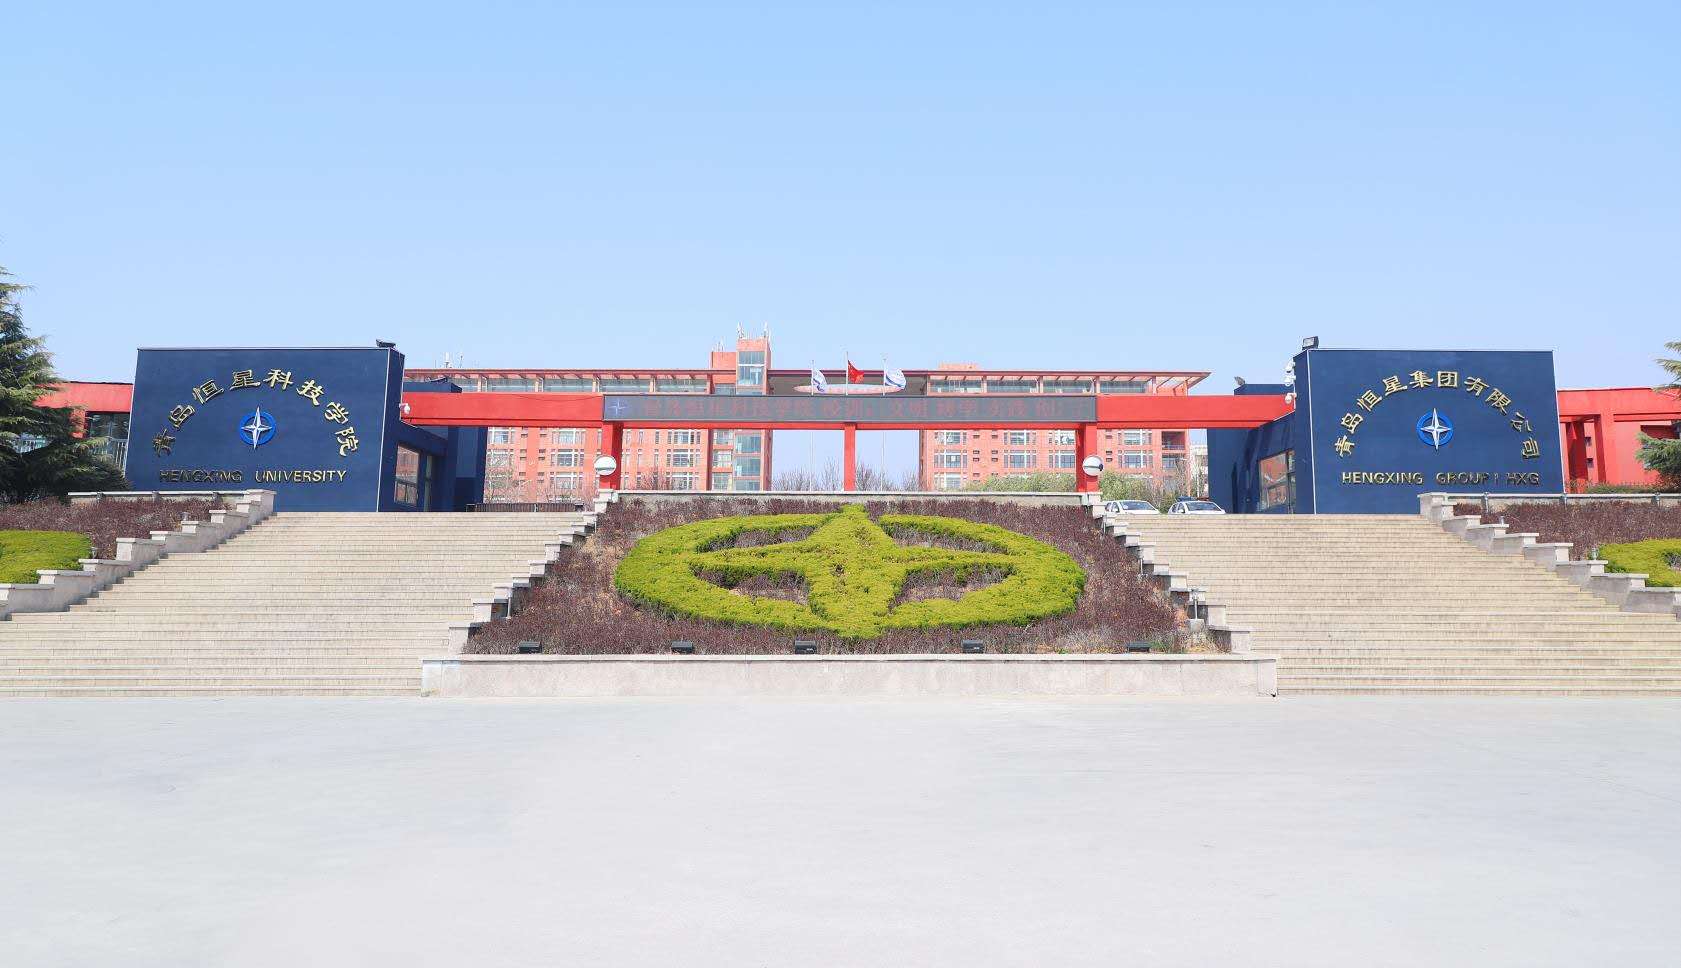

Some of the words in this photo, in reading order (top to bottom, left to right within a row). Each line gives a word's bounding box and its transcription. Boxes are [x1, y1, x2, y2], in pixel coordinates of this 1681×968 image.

[152, 368, 360, 457] 青岛恒星科技学院
[1334, 370, 1541, 459] 青岛恒星集团有限公司
[159, 469, 243, 483] HENGXING
[255, 470, 348, 483] UNIVERSITY
[1342, 471, 1424, 485] HENGXING
[1436, 472, 1490, 485] GROUP
[1506, 472, 1540, 485] HXG
